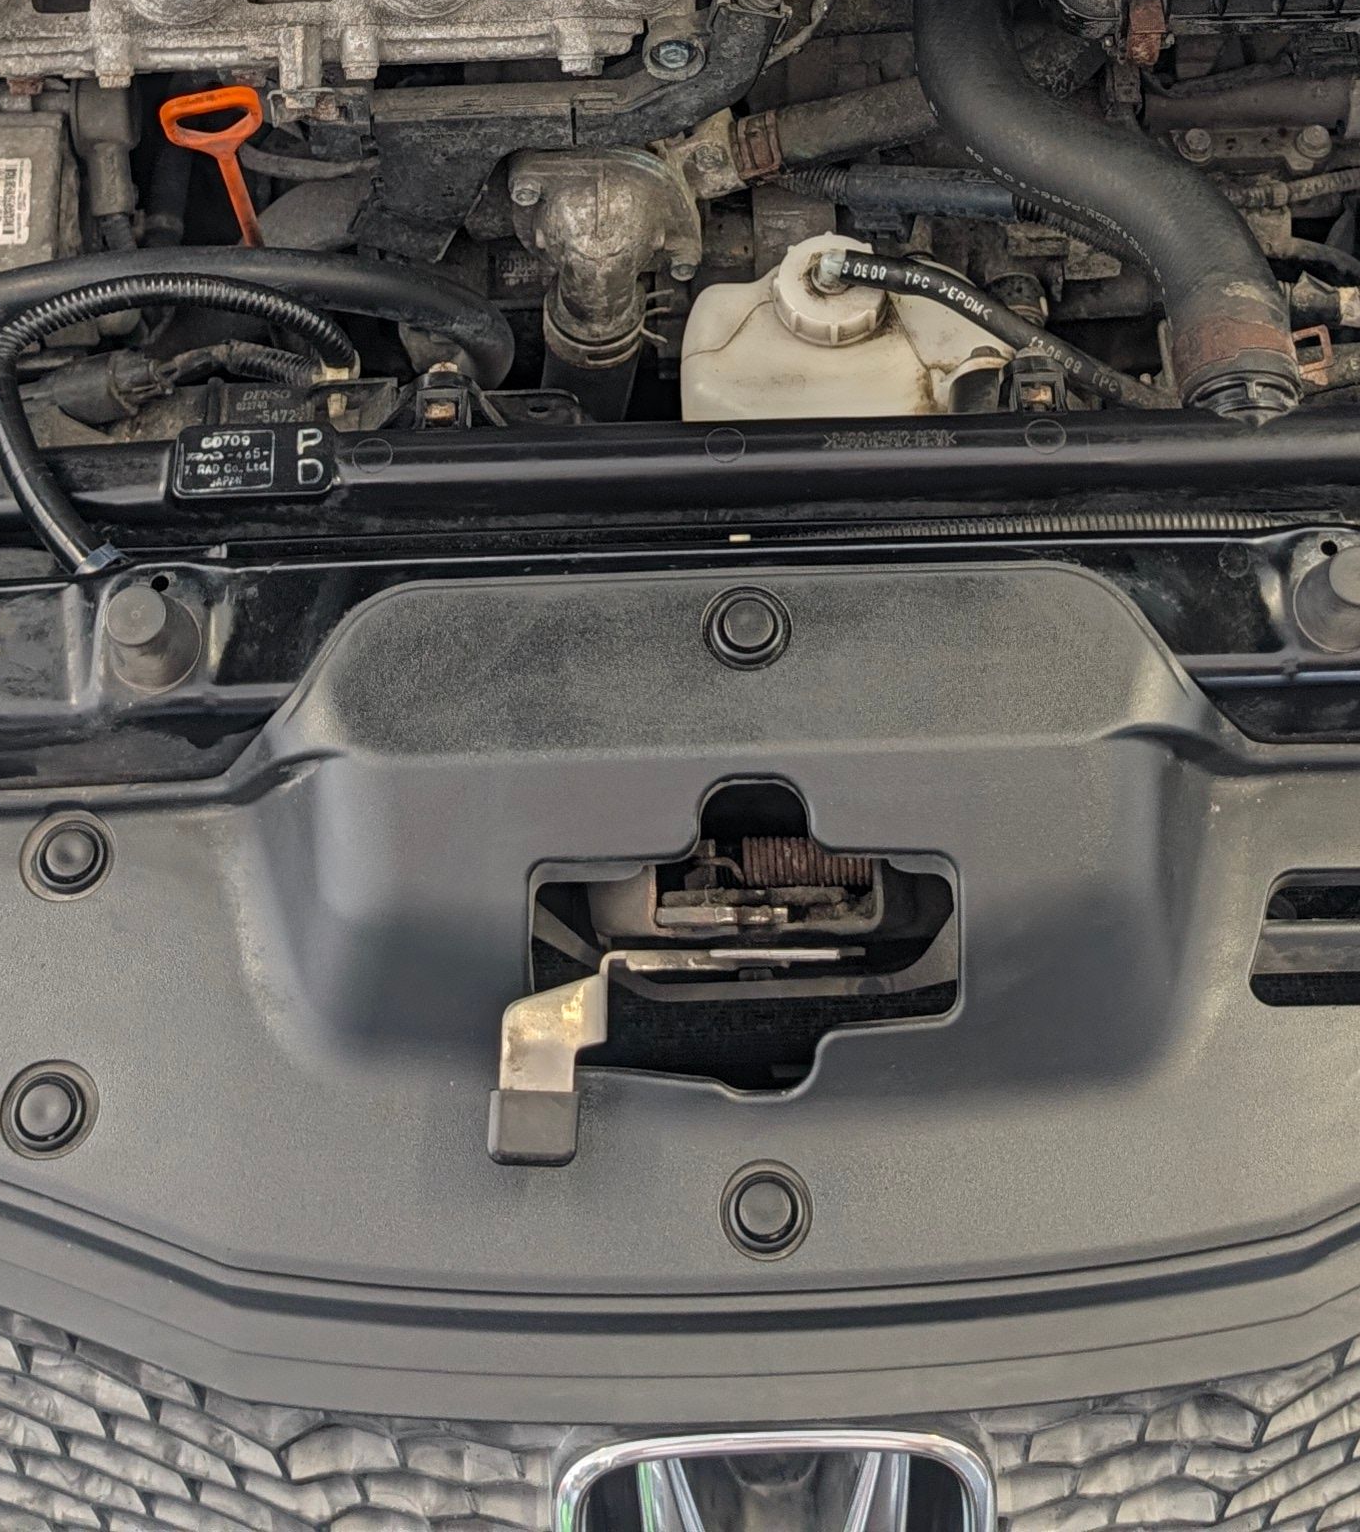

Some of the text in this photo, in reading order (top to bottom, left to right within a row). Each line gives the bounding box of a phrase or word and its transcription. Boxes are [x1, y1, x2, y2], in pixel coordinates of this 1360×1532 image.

[243, 390, 292, 401] DENSO
[296, 428, 323, 456] P
[197, 464, 221, 476] RAD
[297, 458, 324, 485] D
[209, 476, 243, 488] JAPAN
